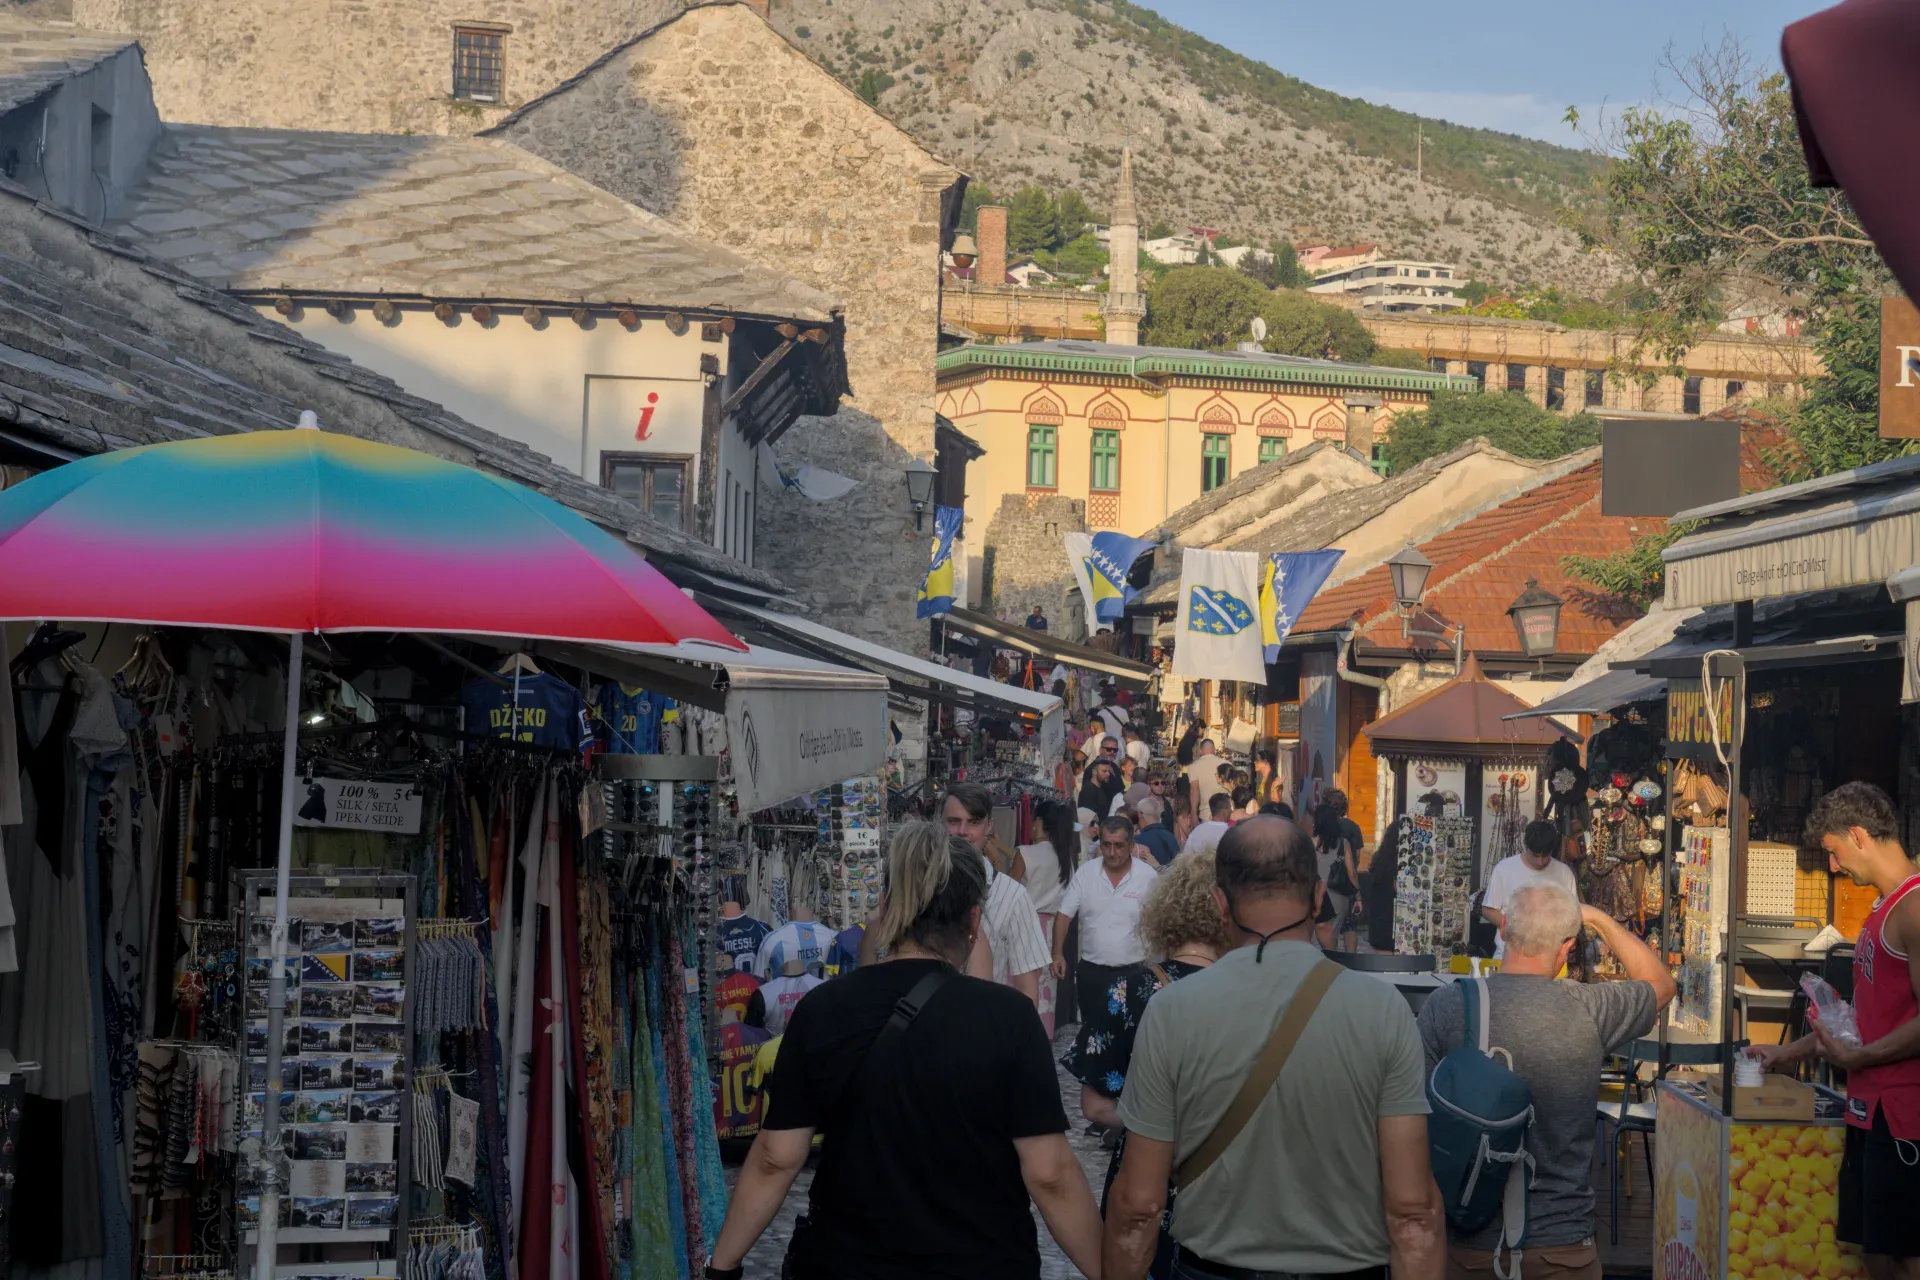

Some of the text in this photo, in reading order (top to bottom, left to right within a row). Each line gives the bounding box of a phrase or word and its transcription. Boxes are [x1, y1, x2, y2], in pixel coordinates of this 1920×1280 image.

[490, 703, 547, 728] DŽEKO
[621, 715, 638, 732] 20
[338, 785, 364, 798] 100
[368, 787, 379, 800] %
[393, 788, 402, 801] 5
[337, 798, 362, 811] SILK
[372, 801, 399, 812] SETA
[335, 811, 363, 824] IPEK
[372, 815, 404, 826] SEIDE
[857, 831, 868, 839] 1€
[723, 936, 752, 953] MESSI
[797, 947, 823, 960] MESSI
[727, 987, 751, 999] YAMAL
[356, 1003, 376, 1011] Mostar
[716, 1062, 757, 1117] 10
